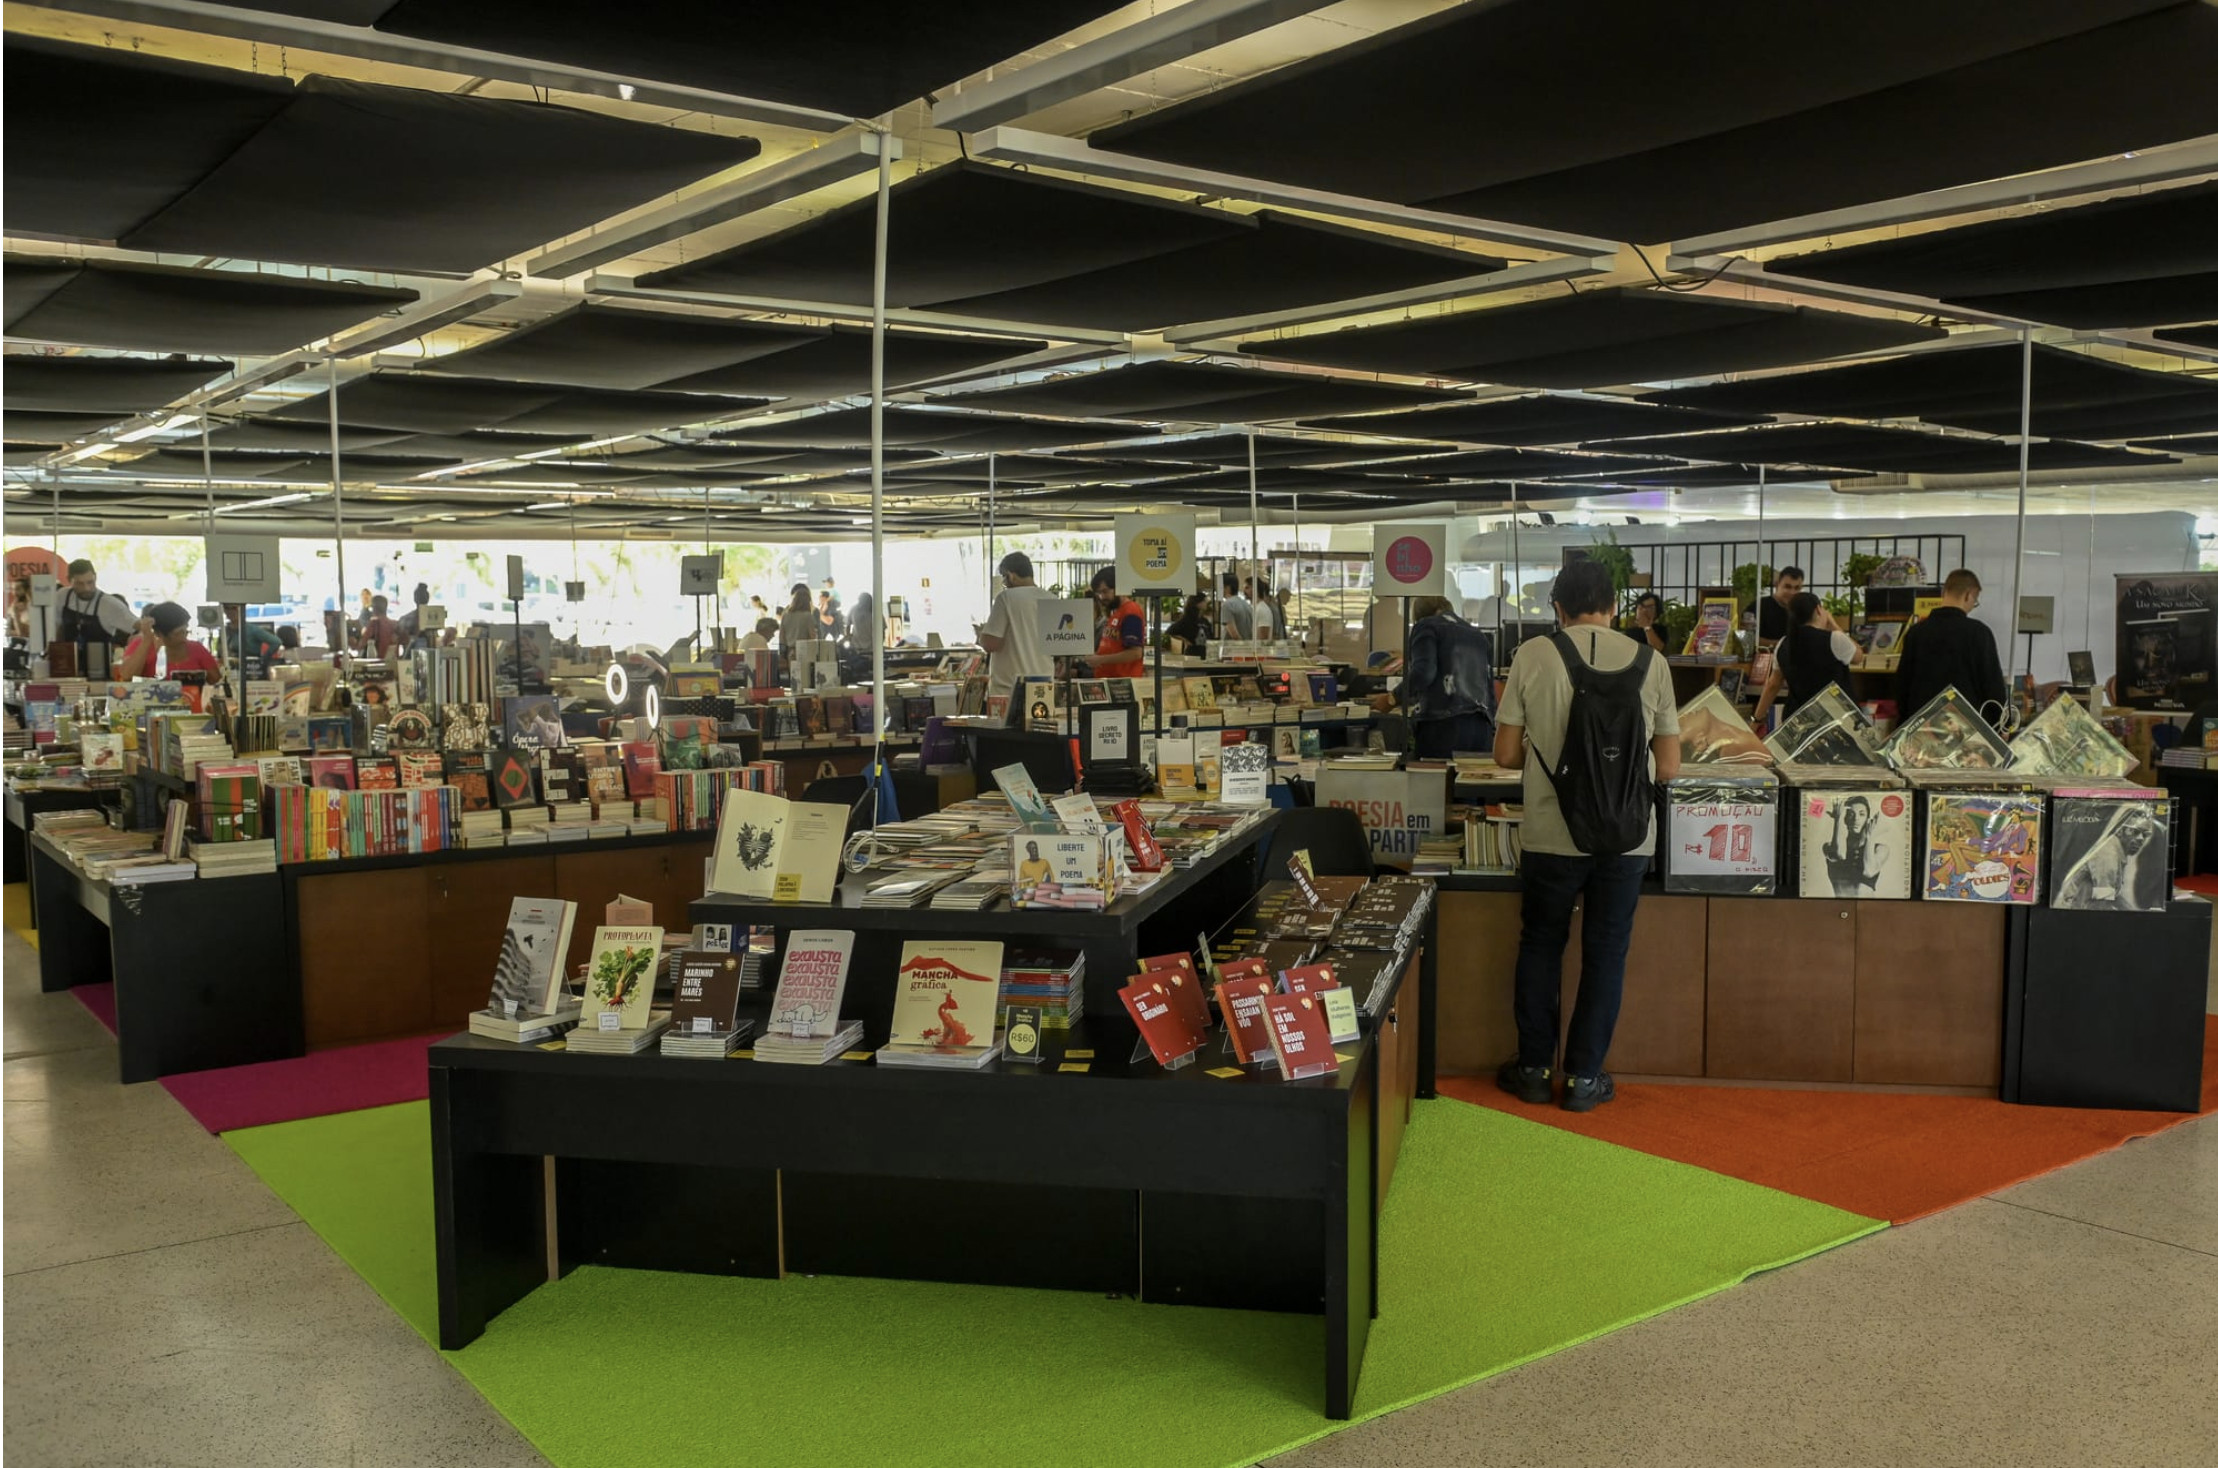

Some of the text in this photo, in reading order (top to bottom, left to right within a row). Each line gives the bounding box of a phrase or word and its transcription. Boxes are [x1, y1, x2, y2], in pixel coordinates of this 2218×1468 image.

[1145, 560, 1167, 568] POEMA
[1045, 631, 1086, 642] A PÁGINA
[1407, 814, 1430, 829] em
[1370, 829, 1430, 853] PART
[1057, 843, 1085, 852] LIBERTE
[1685, 843, 1703, 854] R$
[1065, 857, 1077, 865] UM
[1060, 870, 1083, 879] POEMA
[603, 931, 652, 941] PROTOPLANTA
[788, 950, 842, 963] exausta
[684, 968, 714, 978] MARINHO
[785, 962, 840, 975] exausta
[911, 970, 959, 980] MANCHA
[682, 977, 702, 987] ENTRE
[782, 974, 838, 988] exausta
[910, 979, 947, 992] gráfica
[681, 986, 703, 997] MARÉS
[1136, 1001, 1147, 1012] SER
[1274, 1011, 1296, 1024] HÁ SOL
[1278, 1023, 1289, 1034] EM
[1011, 1034, 1035, 1044] R$60
[1281, 1031, 1305, 1044] NOSSOS
[1285, 1042, 1305, 1054] OLHOS
